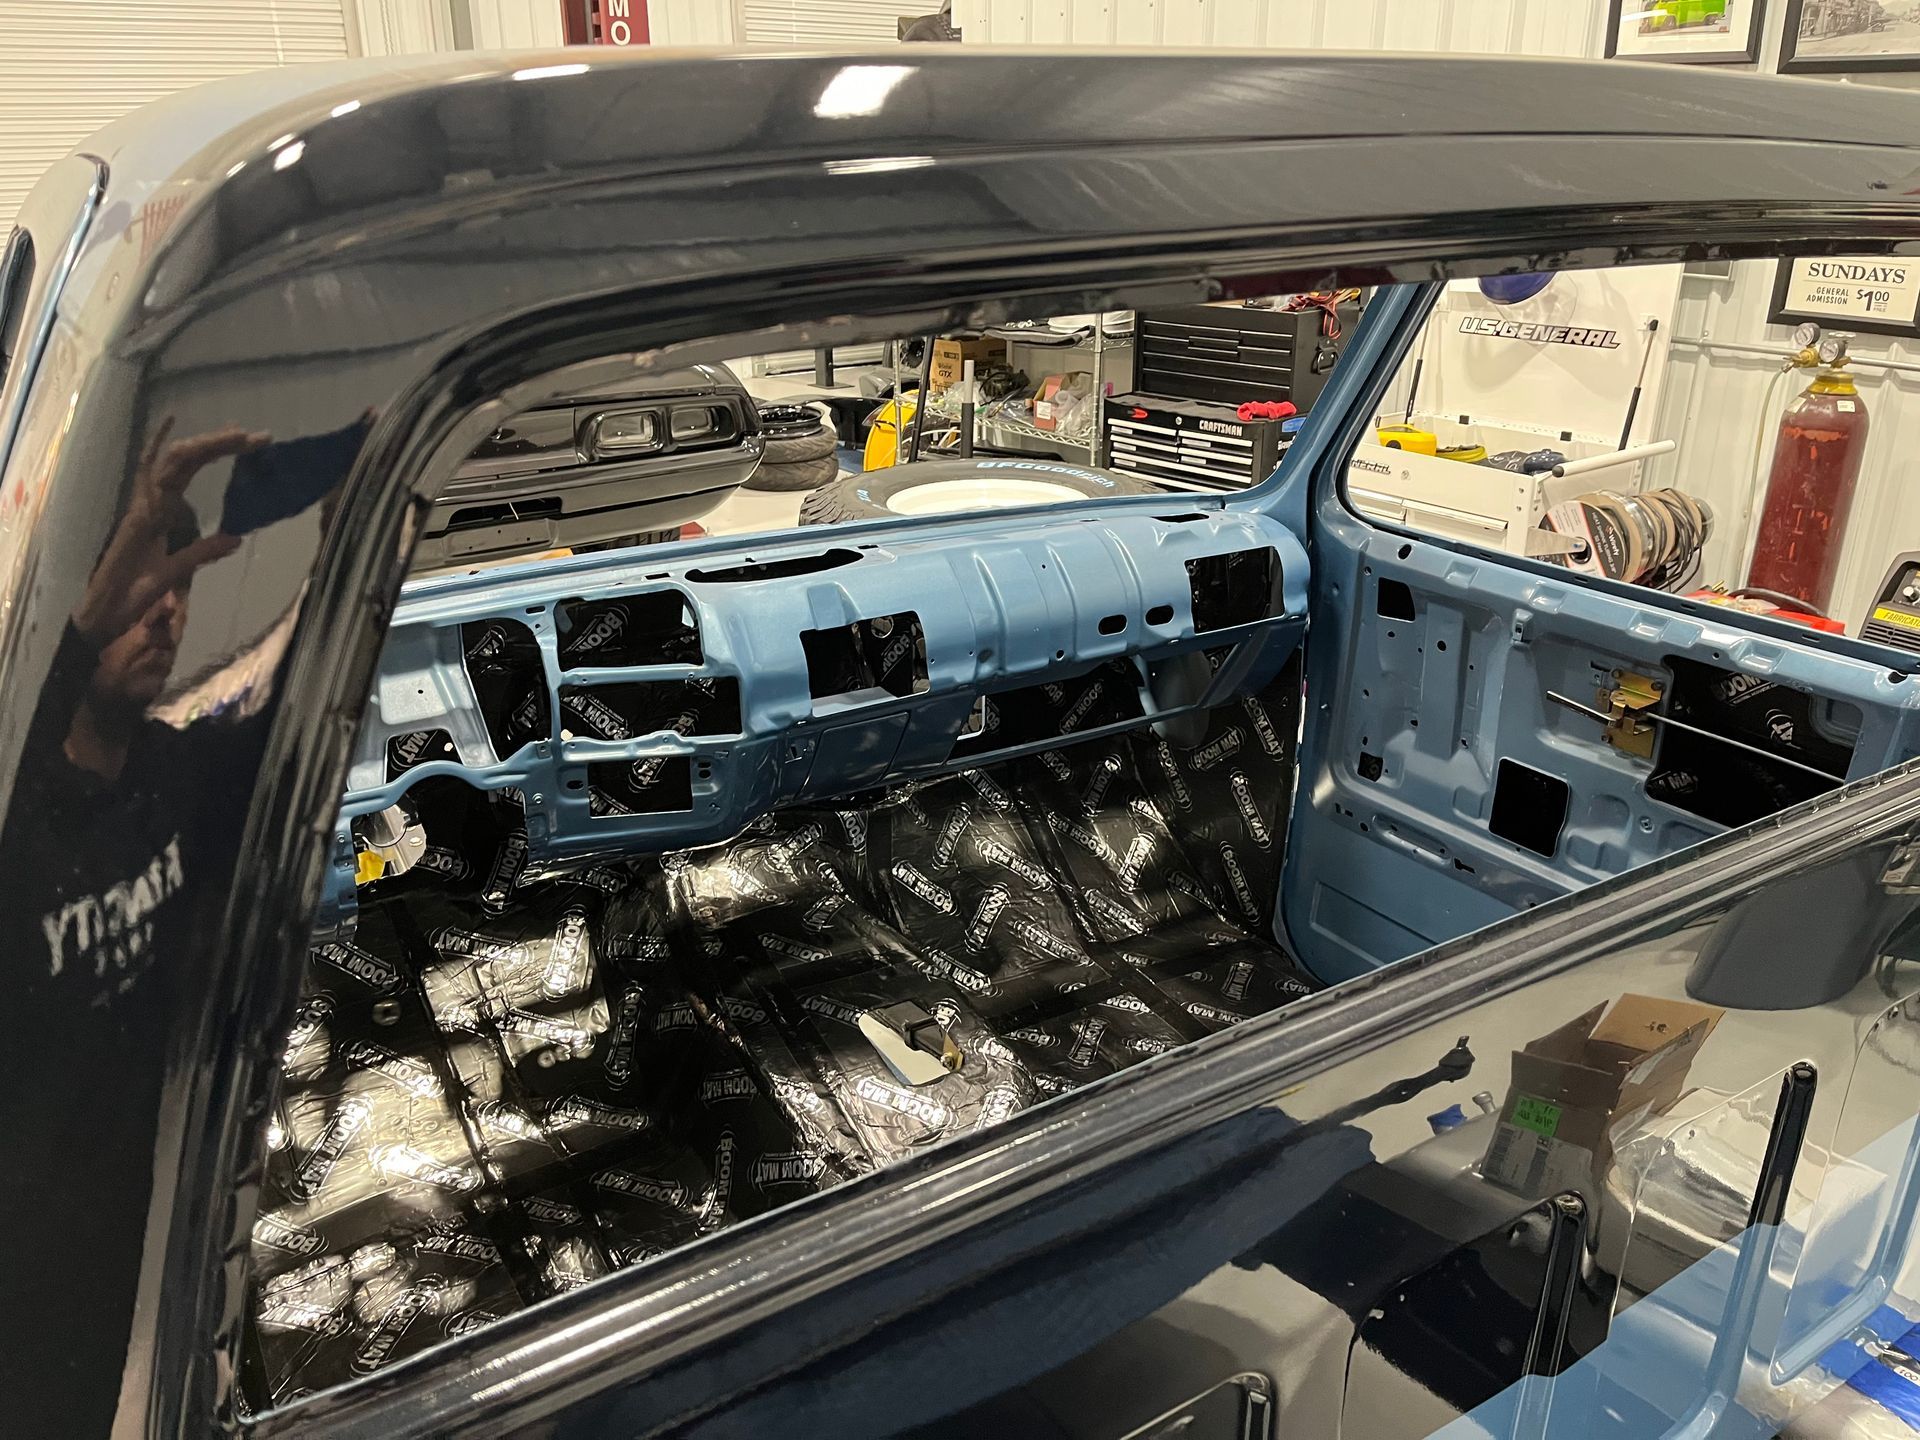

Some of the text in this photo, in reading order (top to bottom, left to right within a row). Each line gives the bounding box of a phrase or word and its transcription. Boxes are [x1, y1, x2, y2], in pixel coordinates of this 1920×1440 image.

[1808, 262, 1905, 284] SUNDAYS
[1806, 294, 1848, 305] ADMISSION
[1816, 286, 1849, 297] GENERAL
[1199, 420, 1243, 436] CRAFTSMAN
[1607, 533, 1620, 557] Wirefy
[1248, 696, 1283, 756] OOM MAT
[1193, 730, 1241, 769] BOOM MAT
[1158, 741, 1190, 804] BOOM MAT
[1231, 776, 1270, 844] BOOM MAT
[420, 852, 464, 877] BOO
[499, 836, 526, 880] BOOM
[914, 881, 954, 913] BOOM
[1222, 850, 1259, 917] BOOM MAT
[347, 954, 400, 990] BOOM
[1280, 981, 1311, 995] MAT
[802, 999, 837, 1016] MAT
[891, 1097, 947, 1127] BOOM
[717, 1138, 733, 1197] BOOM
[755, 1160, 780, 1183] MAT
[631, 1183, 684, 1206] BOOM
[259, 1226, 319, 1254] BOOM
